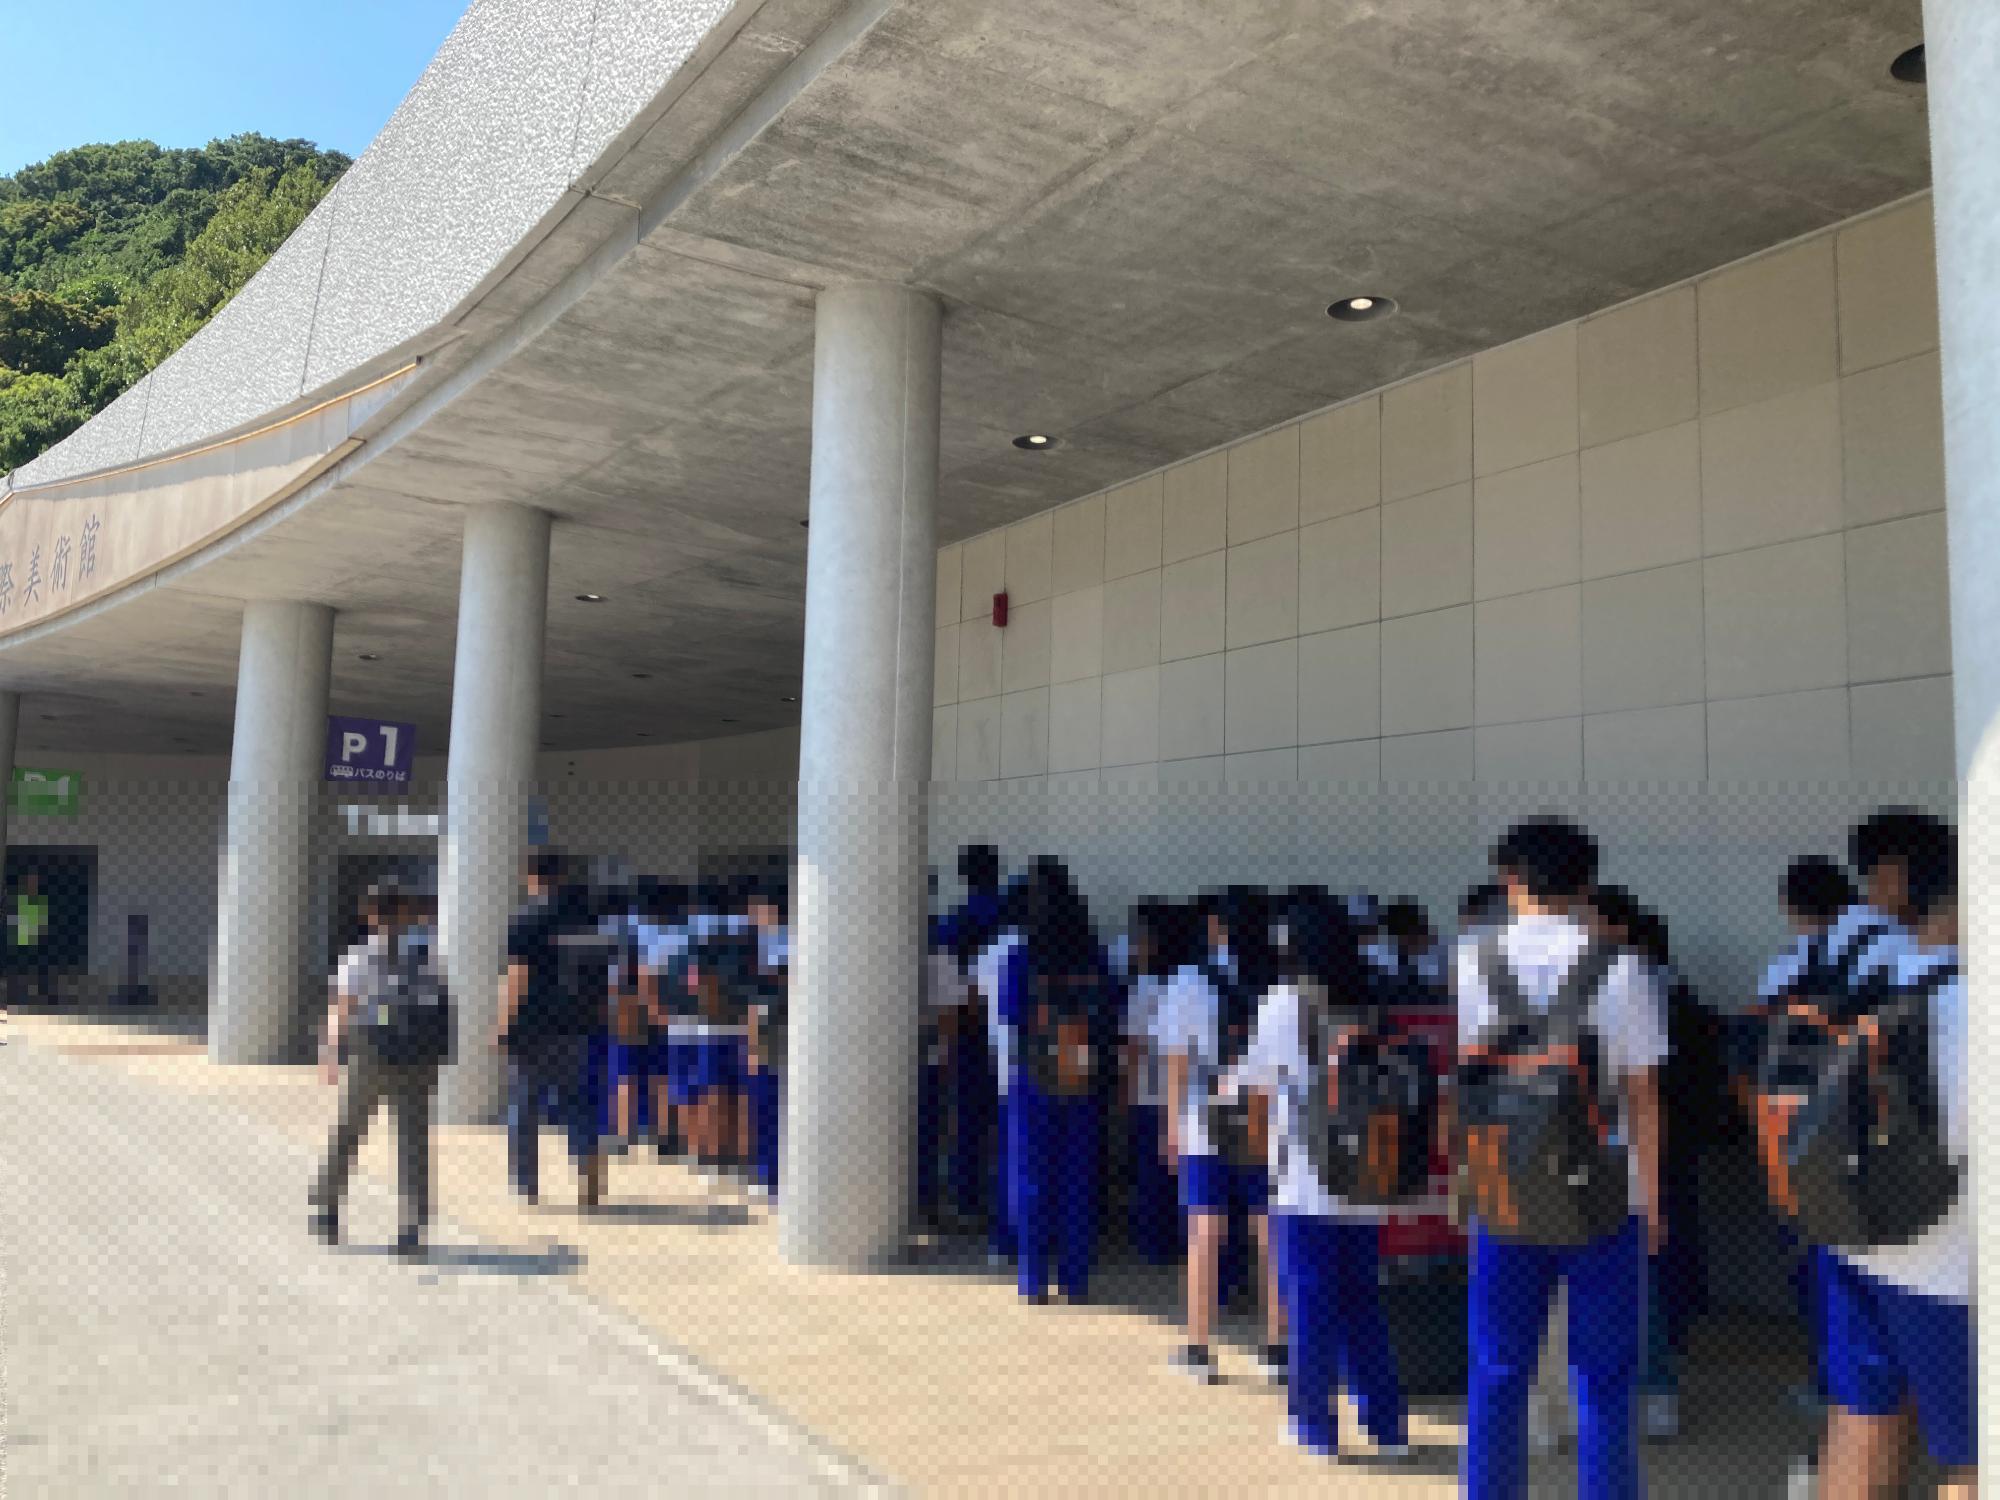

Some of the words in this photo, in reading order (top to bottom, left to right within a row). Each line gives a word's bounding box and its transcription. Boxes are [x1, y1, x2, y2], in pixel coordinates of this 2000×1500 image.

[354, 767, 407, 781] バスのりば
